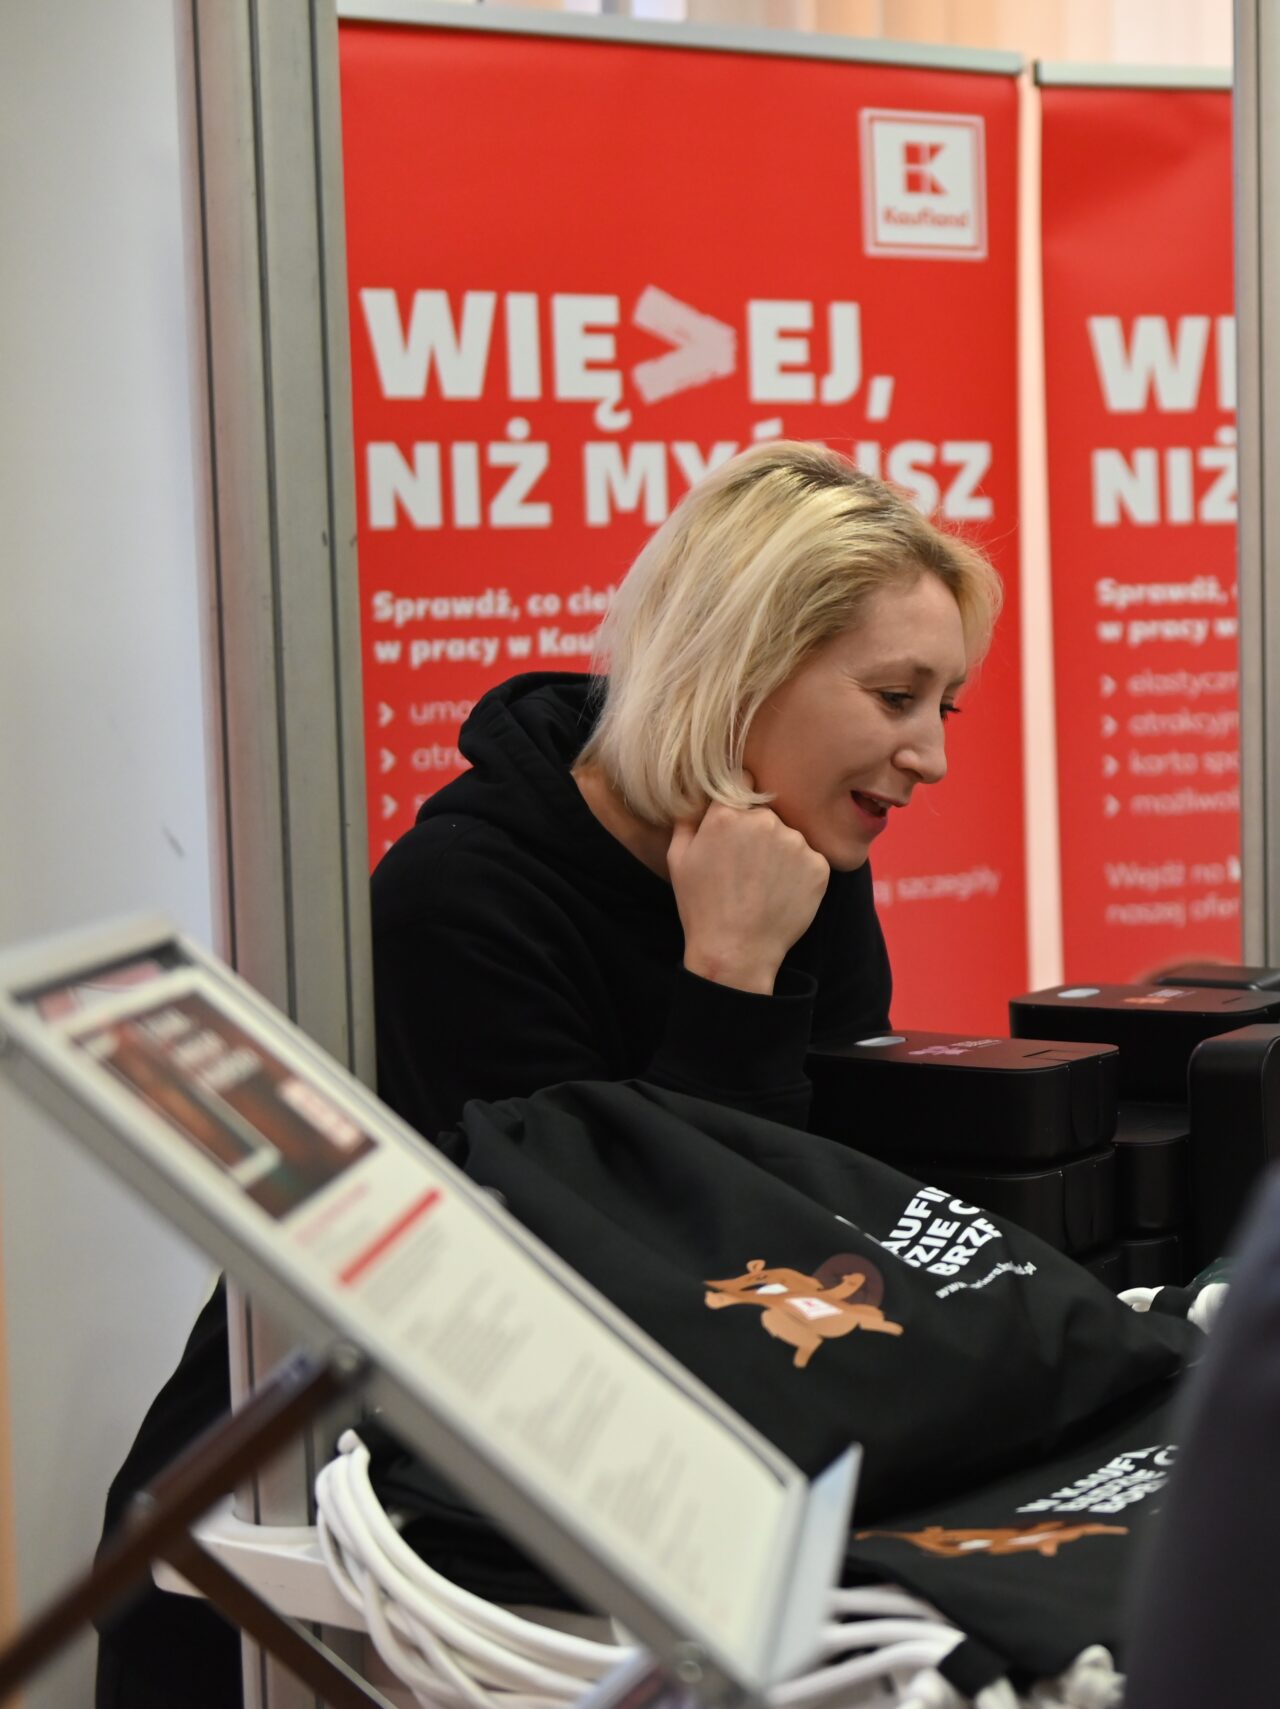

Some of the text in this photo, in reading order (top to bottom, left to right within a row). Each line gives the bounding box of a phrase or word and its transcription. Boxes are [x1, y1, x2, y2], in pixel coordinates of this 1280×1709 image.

[366, 417, 552, 530] NIŻ
[372, 588, 520, 628] Sprawdź,
[527, 593, 562, 616] co
[374, 640, 402, 664] w
[410, 637, 500, 669] pracy
[507, 635, 533, 659] w
